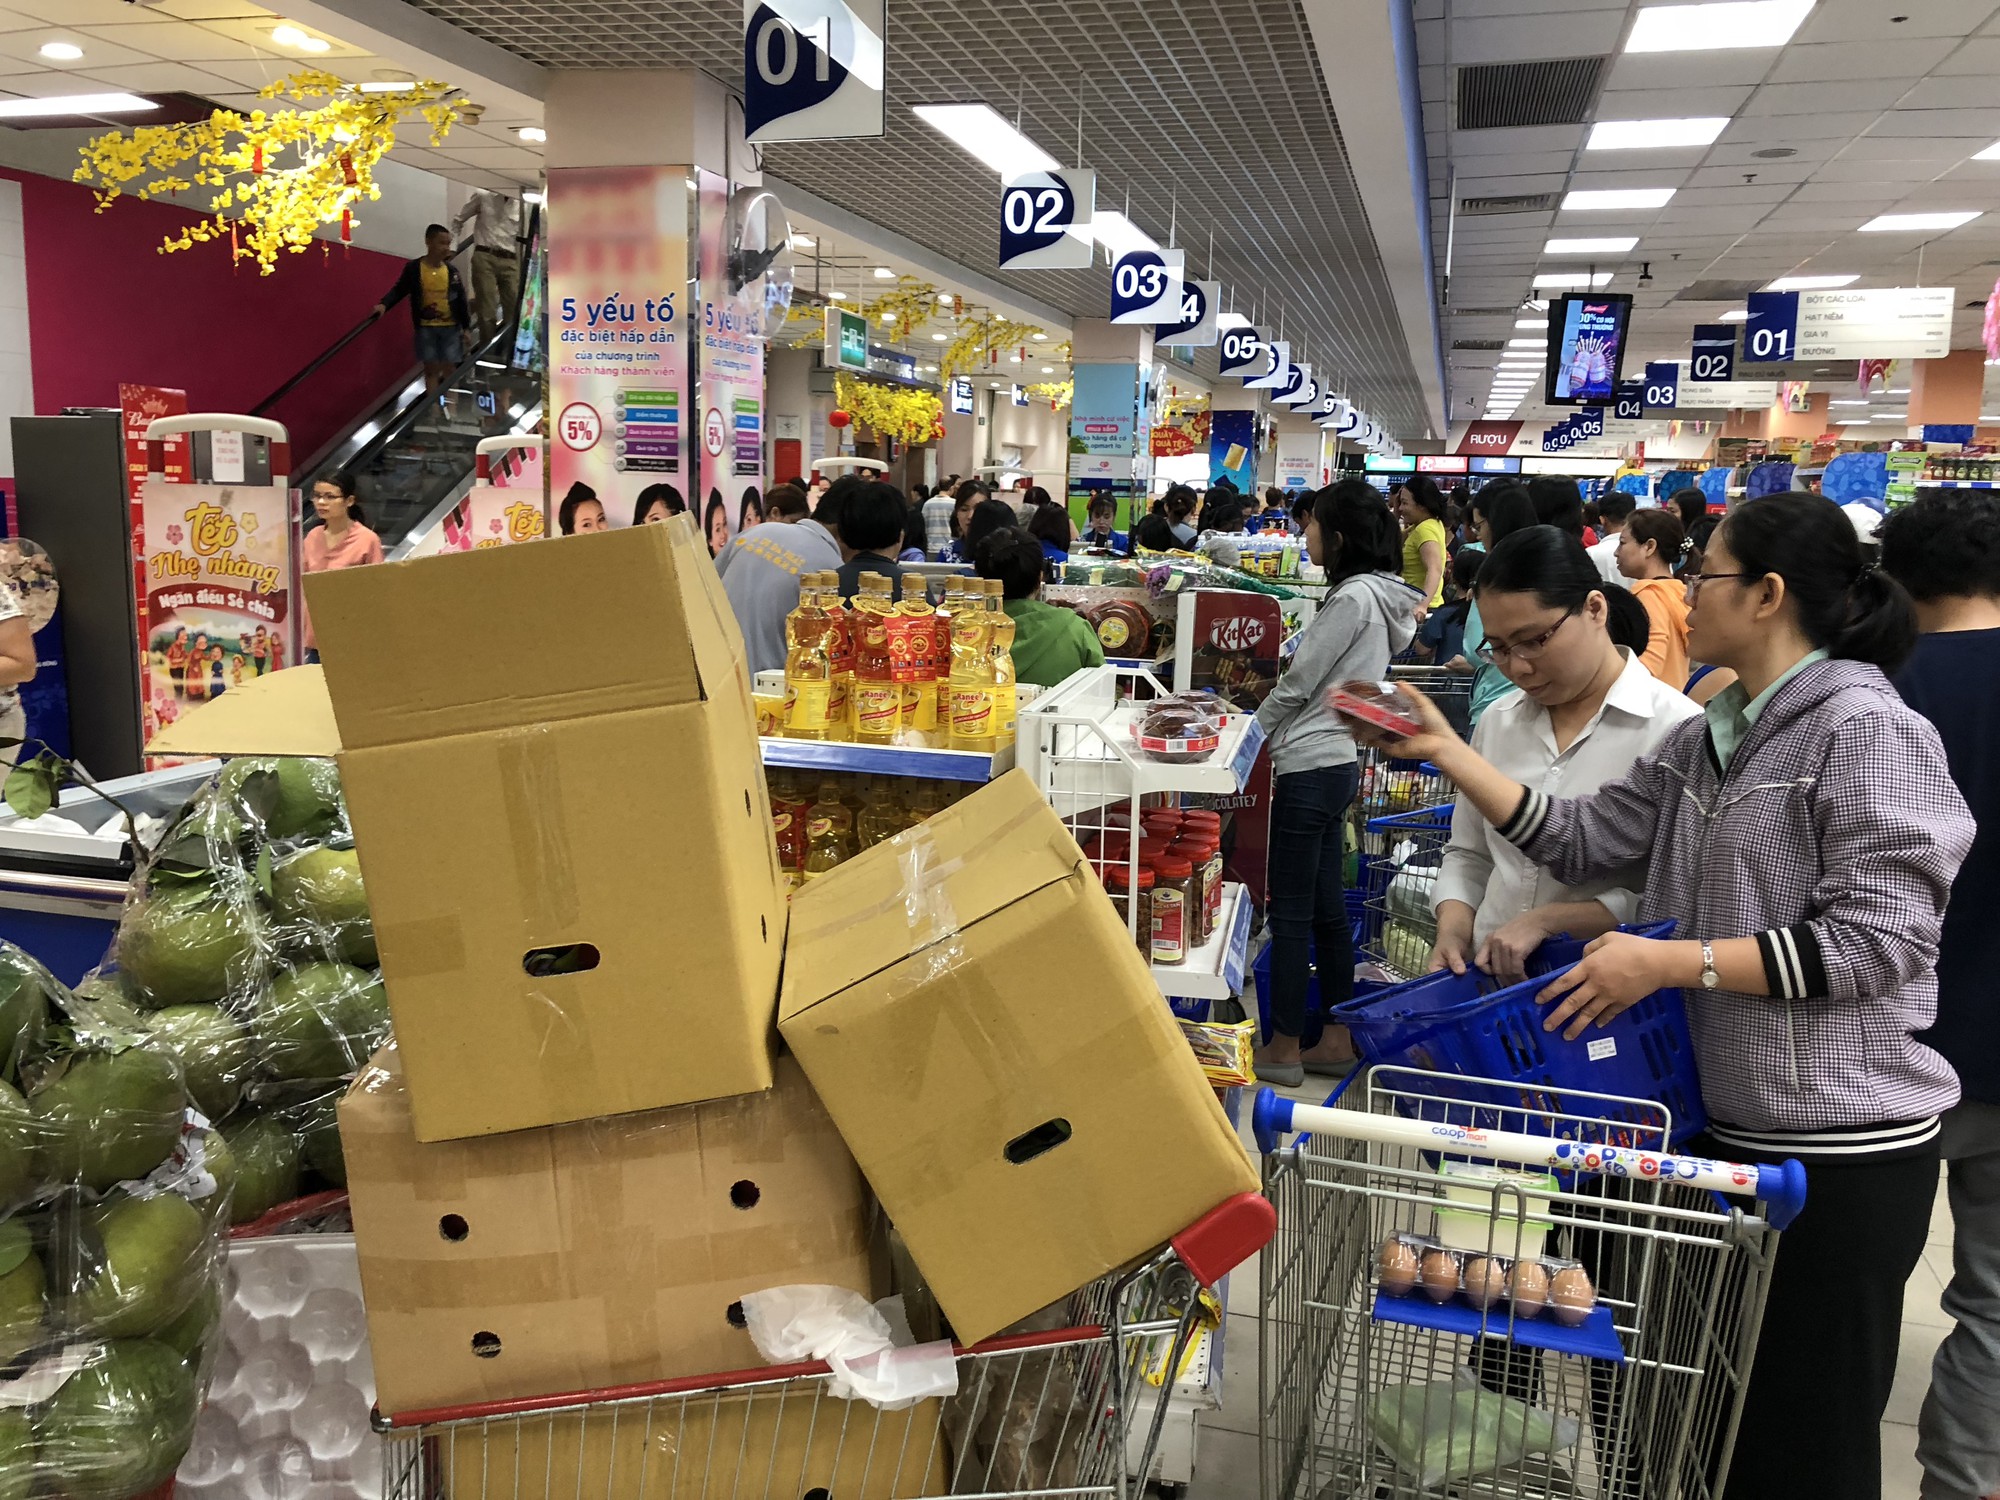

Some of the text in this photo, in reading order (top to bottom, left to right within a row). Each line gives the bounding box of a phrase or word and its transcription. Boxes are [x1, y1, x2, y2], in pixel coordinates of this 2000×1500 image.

[755, 16, 831, 86] 01
[1004, 189, 1064, 235] 02
[1115, 263, 1162, 298] 03
[561, 292, 676, 327] 5 yếu tố
[705, 302, 714, 327] 5
[1179, 294, 1200, 323] 4
[560, 327, 675, 345] đặc biệt hấp dẫn
[1224, 335, 1257, 359] 05
[1752, 328, 1789, 357] 01
[1695, 355, 1729, 379] 02
[1646, 386, 1675, 405] 03
[1618, 400, 1641, 417] 04
[567, 420, 593, 441] 5%
[1583, 421, 1601, 434] 05
[1470, 434, 1507, 447] RƯỢU
[184, 501, 239, 556] Tết
[504, 501, 544, 542] Tết
[150, 550, 280, 595] Nhẹ nhàng
[247, 599, 276, 620] chia
[1217, 617, 1263, 649] KitKat
[864, 690, 888, 698] Ranee
[956, 692, 980, 700] Ranee
